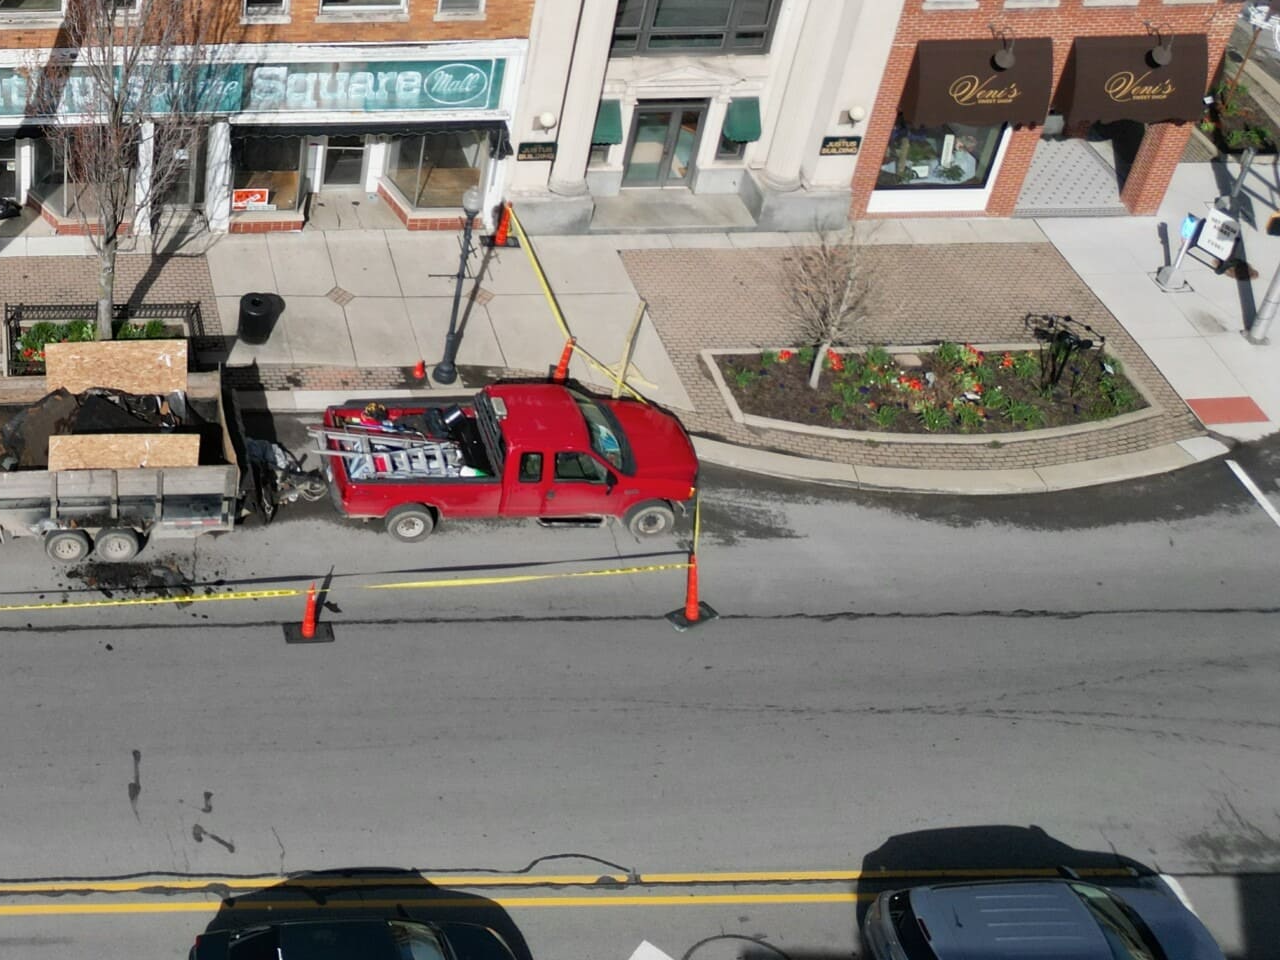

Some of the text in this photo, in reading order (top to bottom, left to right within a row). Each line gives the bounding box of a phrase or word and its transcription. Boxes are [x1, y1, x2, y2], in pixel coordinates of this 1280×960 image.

[252, 66, 422, 108] Square
[431, 70, 480, 93] Mall
[948, 74, 1022, 106] Veni's
[1104, 70, 1176, 103] Veni's
